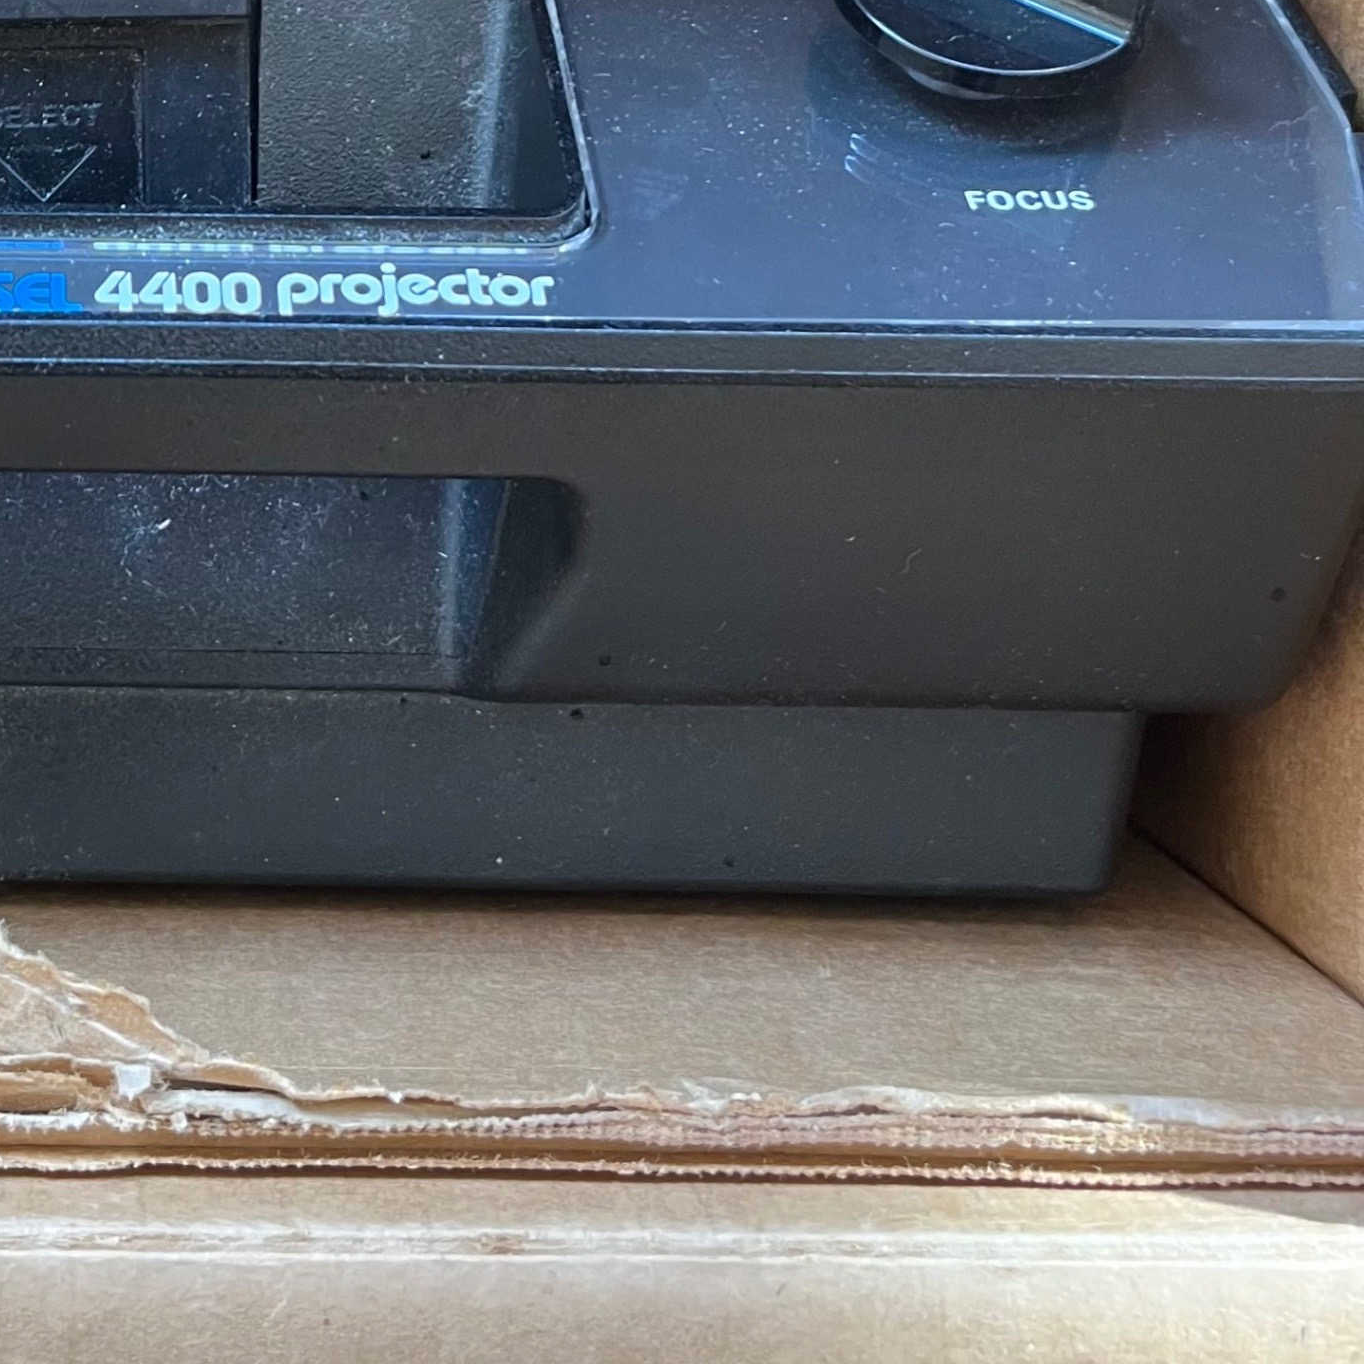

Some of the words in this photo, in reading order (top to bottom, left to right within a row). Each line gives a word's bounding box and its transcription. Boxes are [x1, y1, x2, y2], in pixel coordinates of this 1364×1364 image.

[962, 189, 1097, 212] FOCUS
[92, 269, 263, 314] 4400
[276, 261, 555, 317] projector
